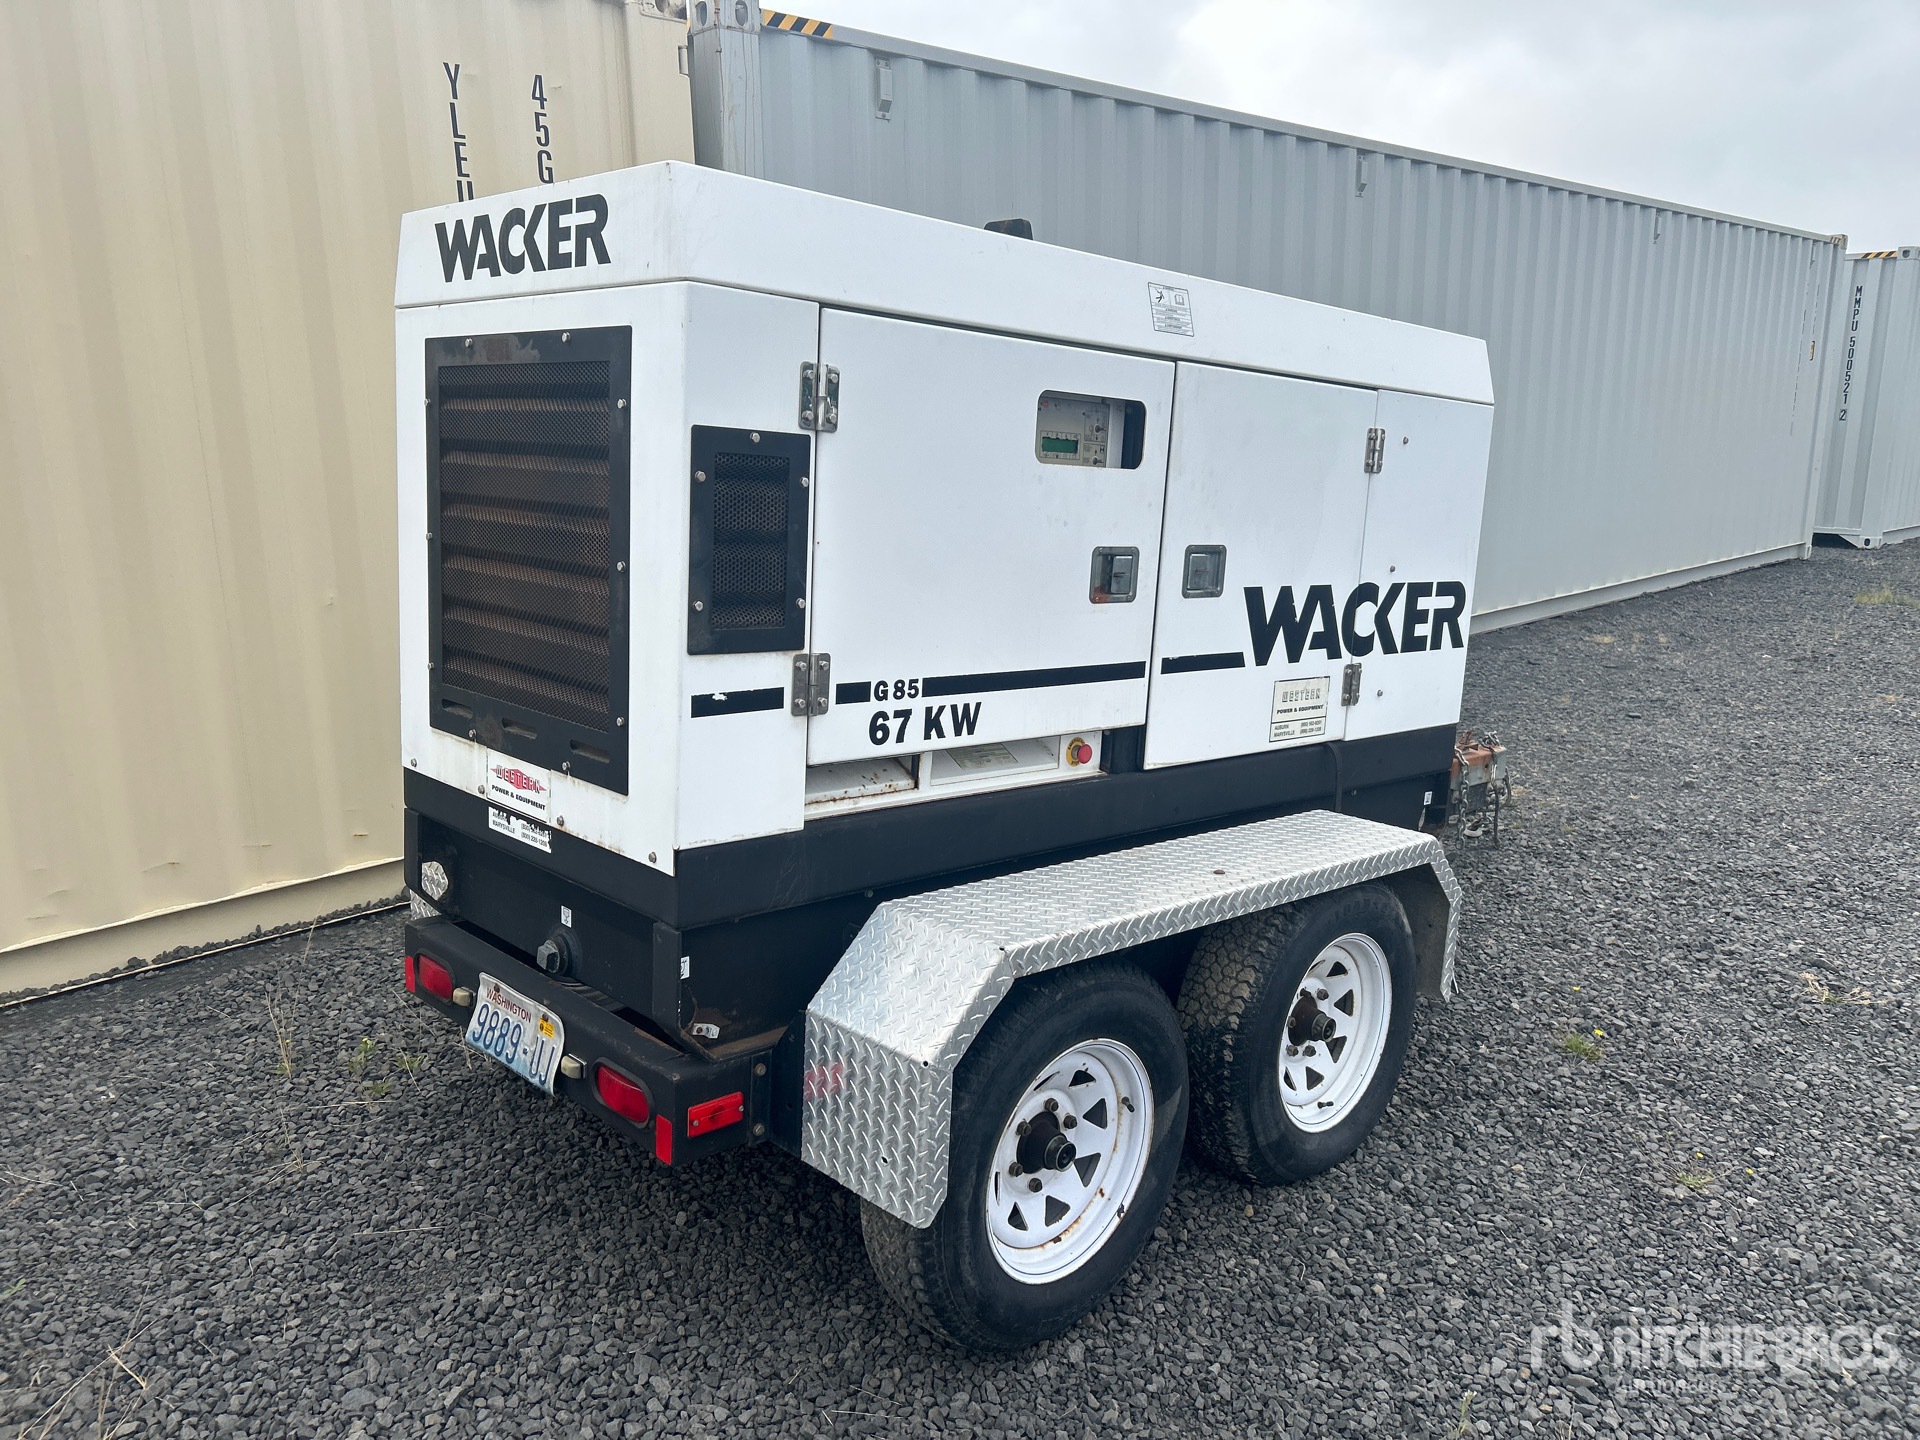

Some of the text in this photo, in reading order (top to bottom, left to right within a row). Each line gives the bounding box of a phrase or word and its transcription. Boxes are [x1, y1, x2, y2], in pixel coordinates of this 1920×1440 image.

[435, 194, 611, 283] WACKER
[1839, 286, 1863, 421] MMPU 500521 2
[1244, 581, 1466, 667] WACKER
[1282, 688, 1320, 702] WESTERN
[1298, 704, 1324, 712] EQUIPMENT
[869, 702, 982, 746] 67 KW
[496, 765, 540, 794] WESTERN
[491, 785, 510, 797] POWER
[515, 793, 546, 811] EQUIPMENT
[492, 819, 516, 834] MARYSVILLE
[486, 987, 532, 1023] WASHINGTON
